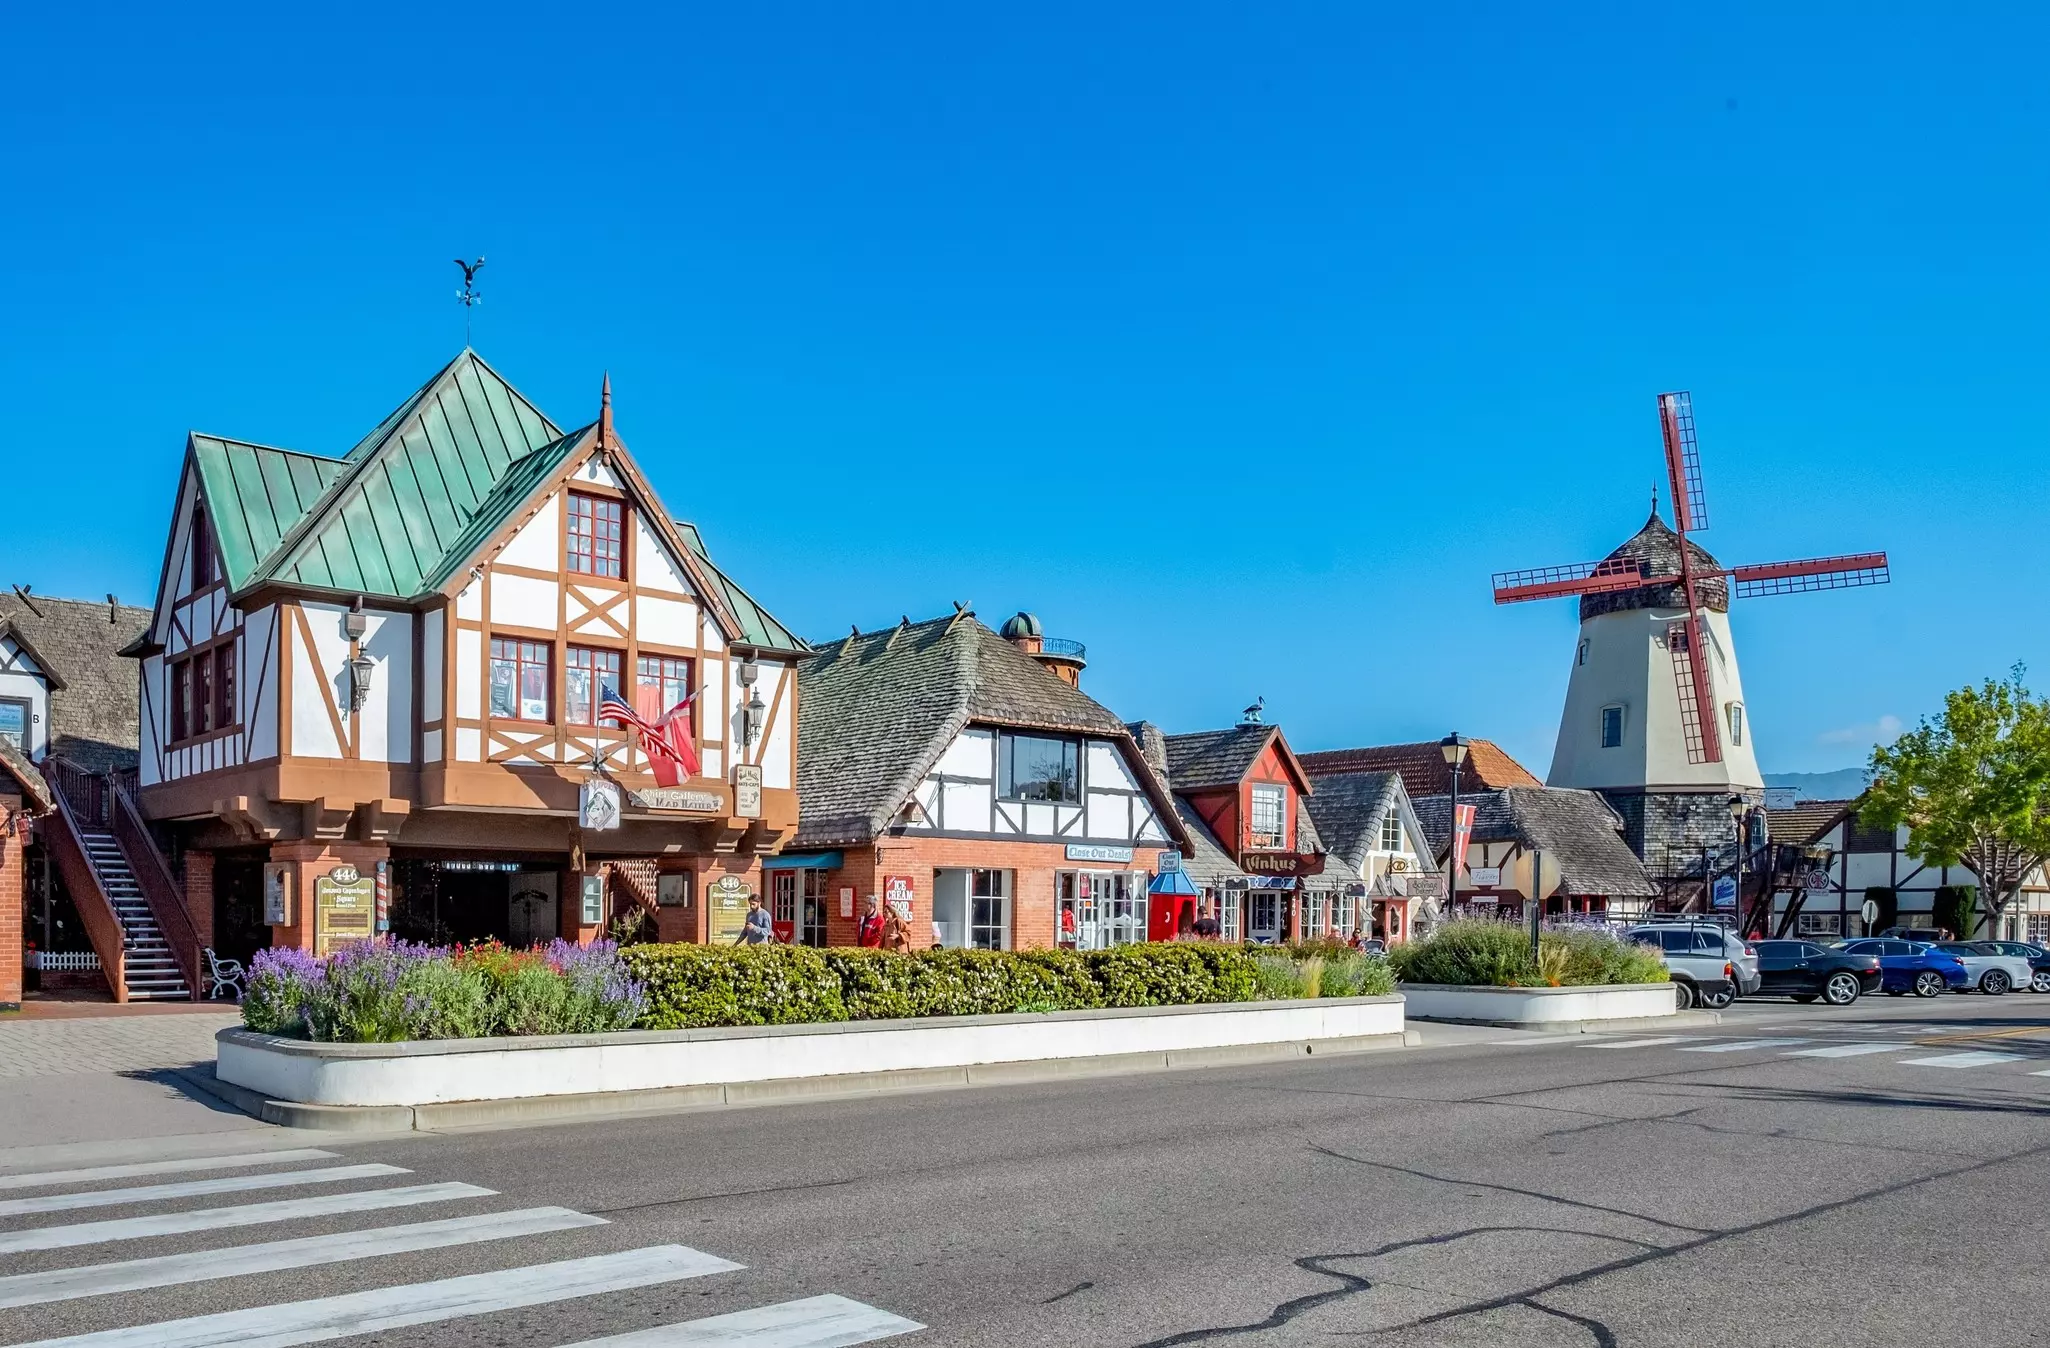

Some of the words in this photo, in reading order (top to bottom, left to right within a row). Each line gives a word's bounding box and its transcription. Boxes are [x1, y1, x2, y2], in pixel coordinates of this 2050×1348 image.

[33, 714, 40, 724] B
[1069, 847, 1089, 858] Close
[1091, 848, 1106, 859] Out
[1246, 855, 1297, 871] Vinhus
[334, 869, 357, 880] 446
[721, 877, 739, 888] 446
[894, 880, 906, 890] ICE
[887, 890, 913, 900] CREAM
